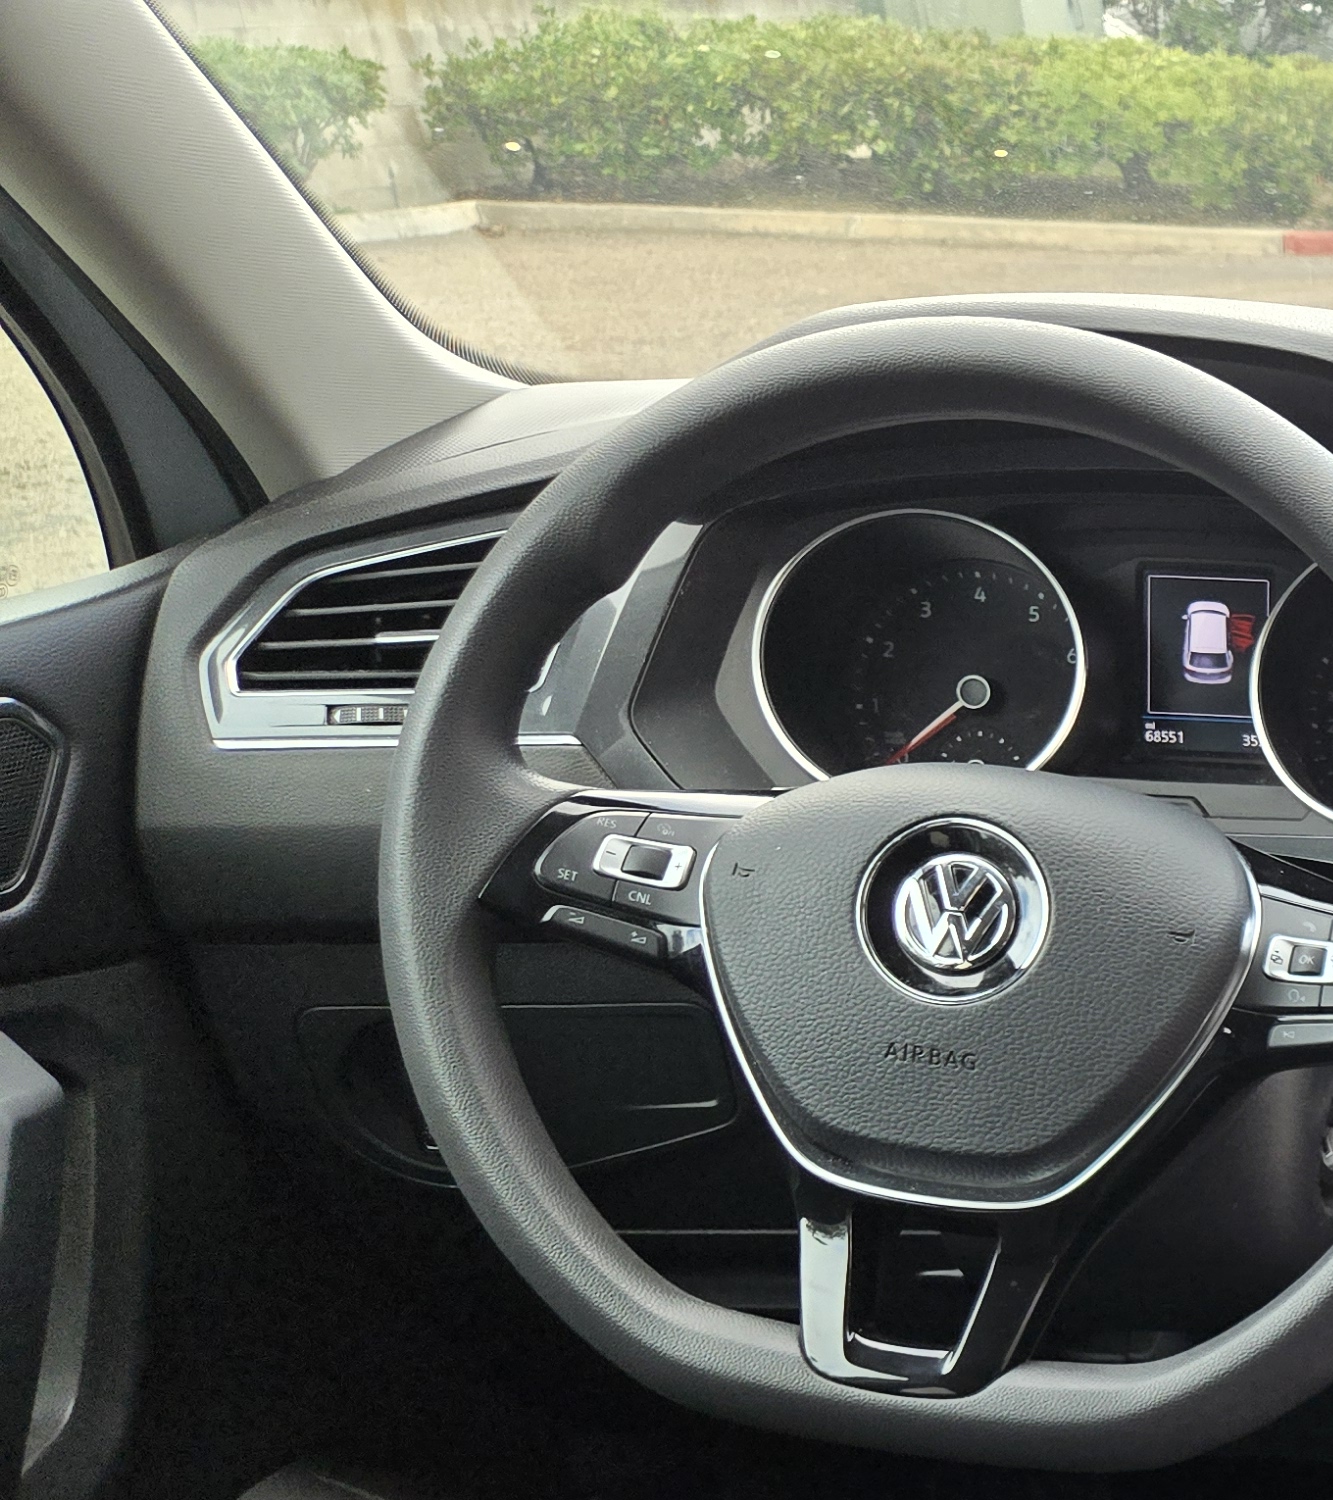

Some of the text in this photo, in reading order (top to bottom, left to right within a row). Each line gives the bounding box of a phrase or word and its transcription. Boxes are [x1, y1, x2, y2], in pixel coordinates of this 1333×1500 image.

[974, 587, 986, 602] 4
[920, 602, 932, 618] 3
[1028, 607, 1039, 622] 5
[883, 642, 895, 658] 2
[1067, 648, 1078, 665] 6
[1145, 730, 1184, 744] 68551
[596, 816, 617, 829] RES
[557, 867, 579, 882] SET
[628, 890, 652, 905] CNL
[1298, 954, 1315, 966] OK
[884, 1041, 977, 1071] AIRBAG
